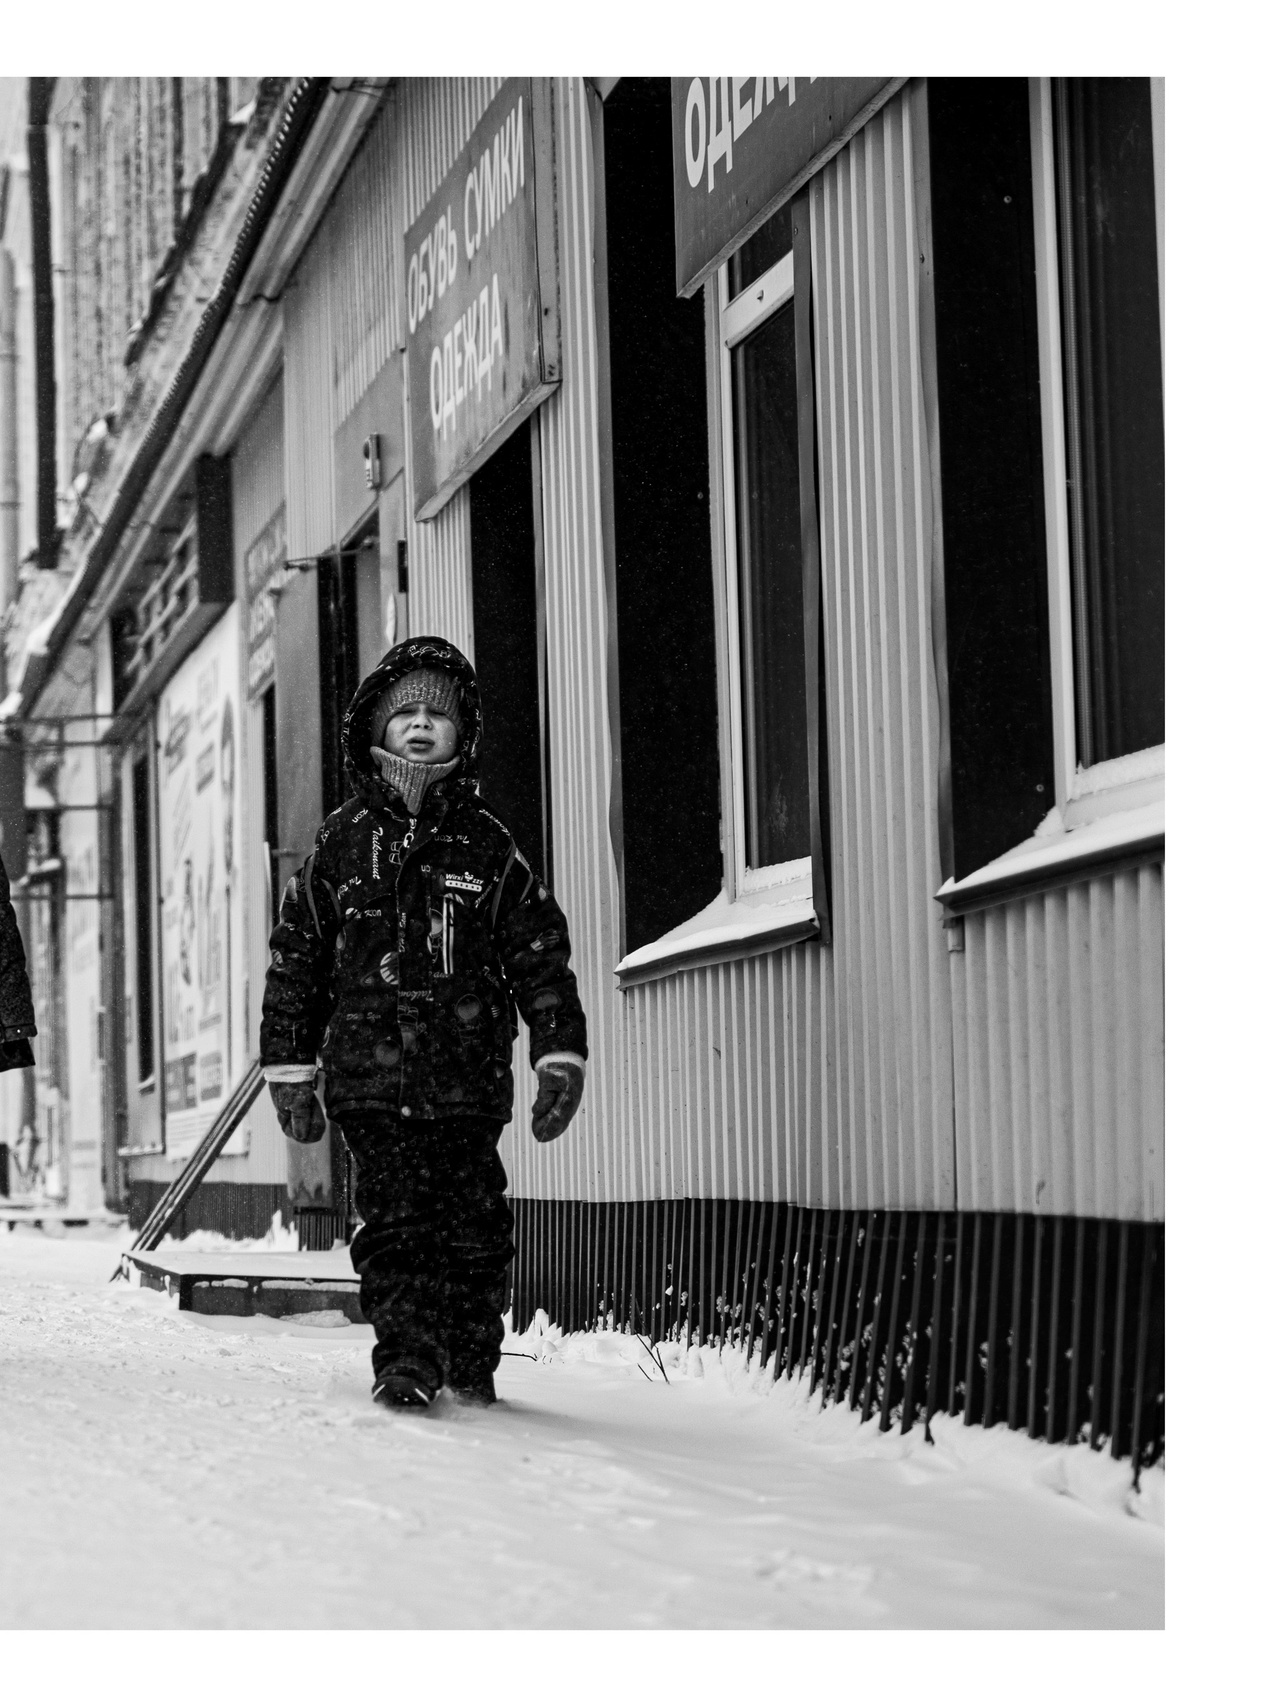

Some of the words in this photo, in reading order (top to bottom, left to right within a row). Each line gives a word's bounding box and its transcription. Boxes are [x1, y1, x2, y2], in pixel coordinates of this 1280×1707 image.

[685, 77, 818, 194] ОДЕ
[407, 203, 458, 335] ОБУВЬ
[464, 94, 525, 261] СУМКИ
[429, 272, 504, 442] ОДЕЖДА
[371, 826, 384, 880] Taikonaut
